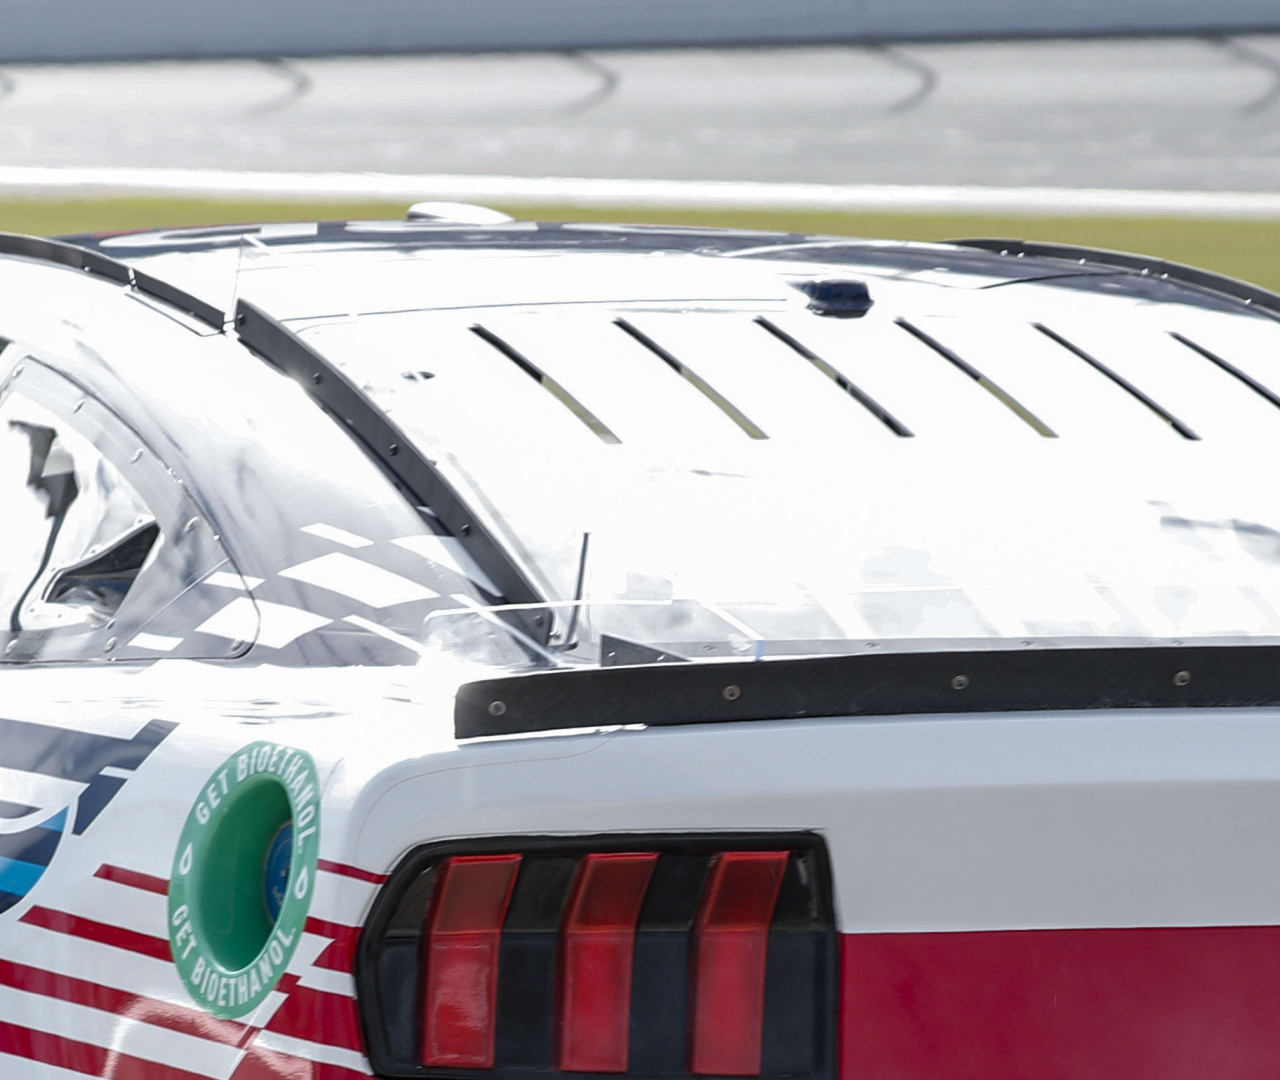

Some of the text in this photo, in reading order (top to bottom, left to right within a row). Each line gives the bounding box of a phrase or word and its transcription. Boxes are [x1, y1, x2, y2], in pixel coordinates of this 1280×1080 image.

[196, 744, 317, 854] GET BIOETHANOL
[172, 904, 297, 1008] GET BIOETHANOL
